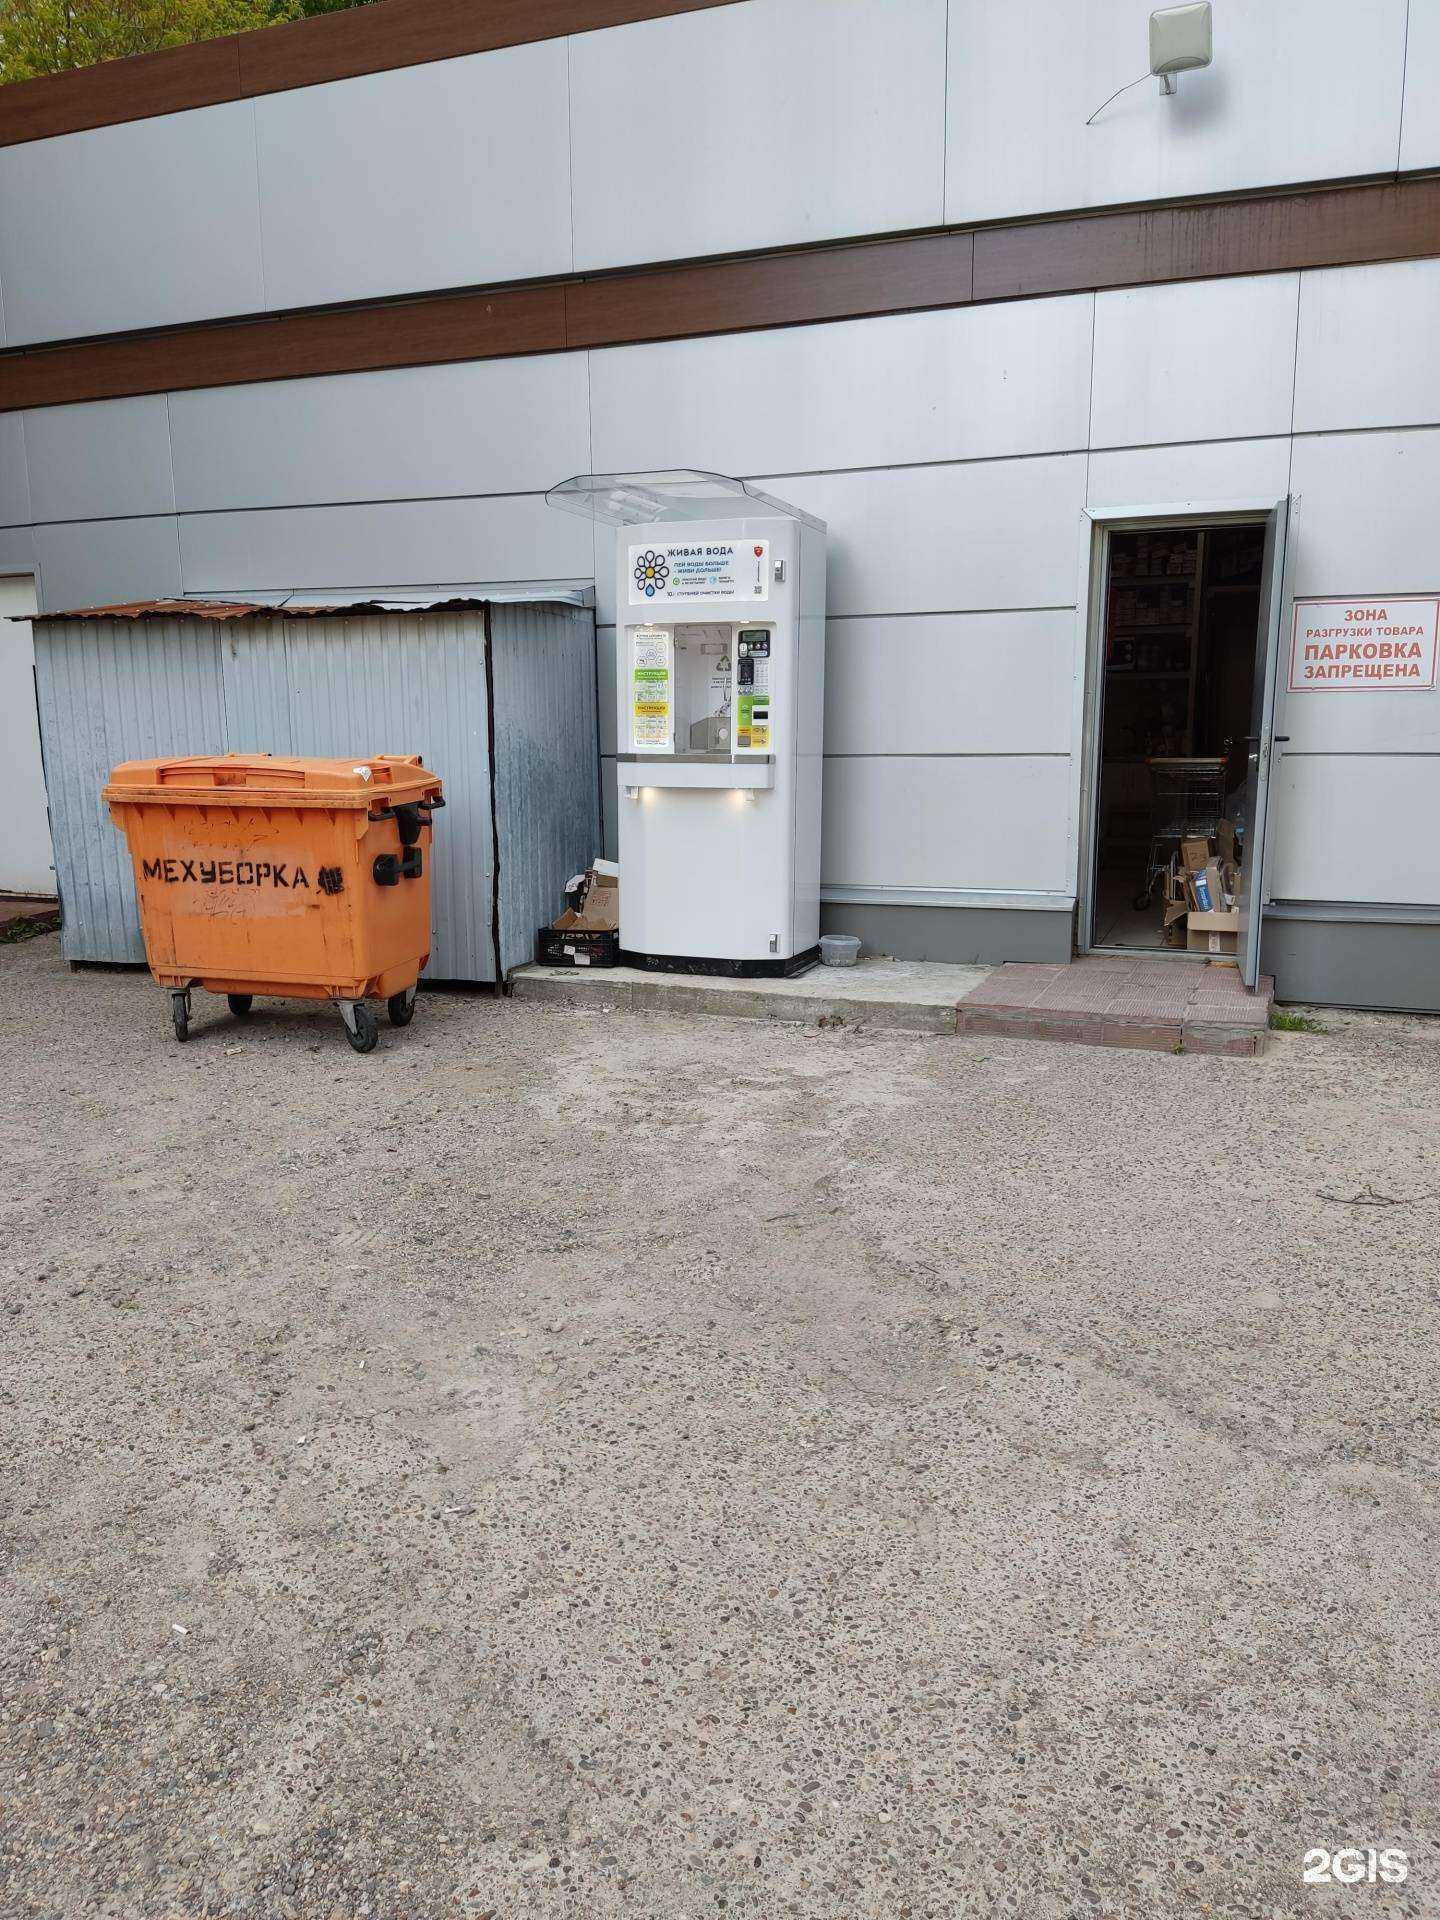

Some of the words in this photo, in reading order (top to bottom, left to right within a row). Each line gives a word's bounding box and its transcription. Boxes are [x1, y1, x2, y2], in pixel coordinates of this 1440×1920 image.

[667, 548, 703, 557] ЖИВАЯ
[706, 546, 734, 556] ВОДА
[1344, 608, 1388, 621] ЗОНА
[1306, 627, 1373, 638] РАЗГРУЗКИ
[1376, 626, 1424, 636] ТОВАРА
[1304, 642, 1422, 660] ПАРКОВКА
[1304, 663, 1420, 680] ЗАПРЕЩЕНА
[142, 857, 310, 889] МЕХУБОРКА
